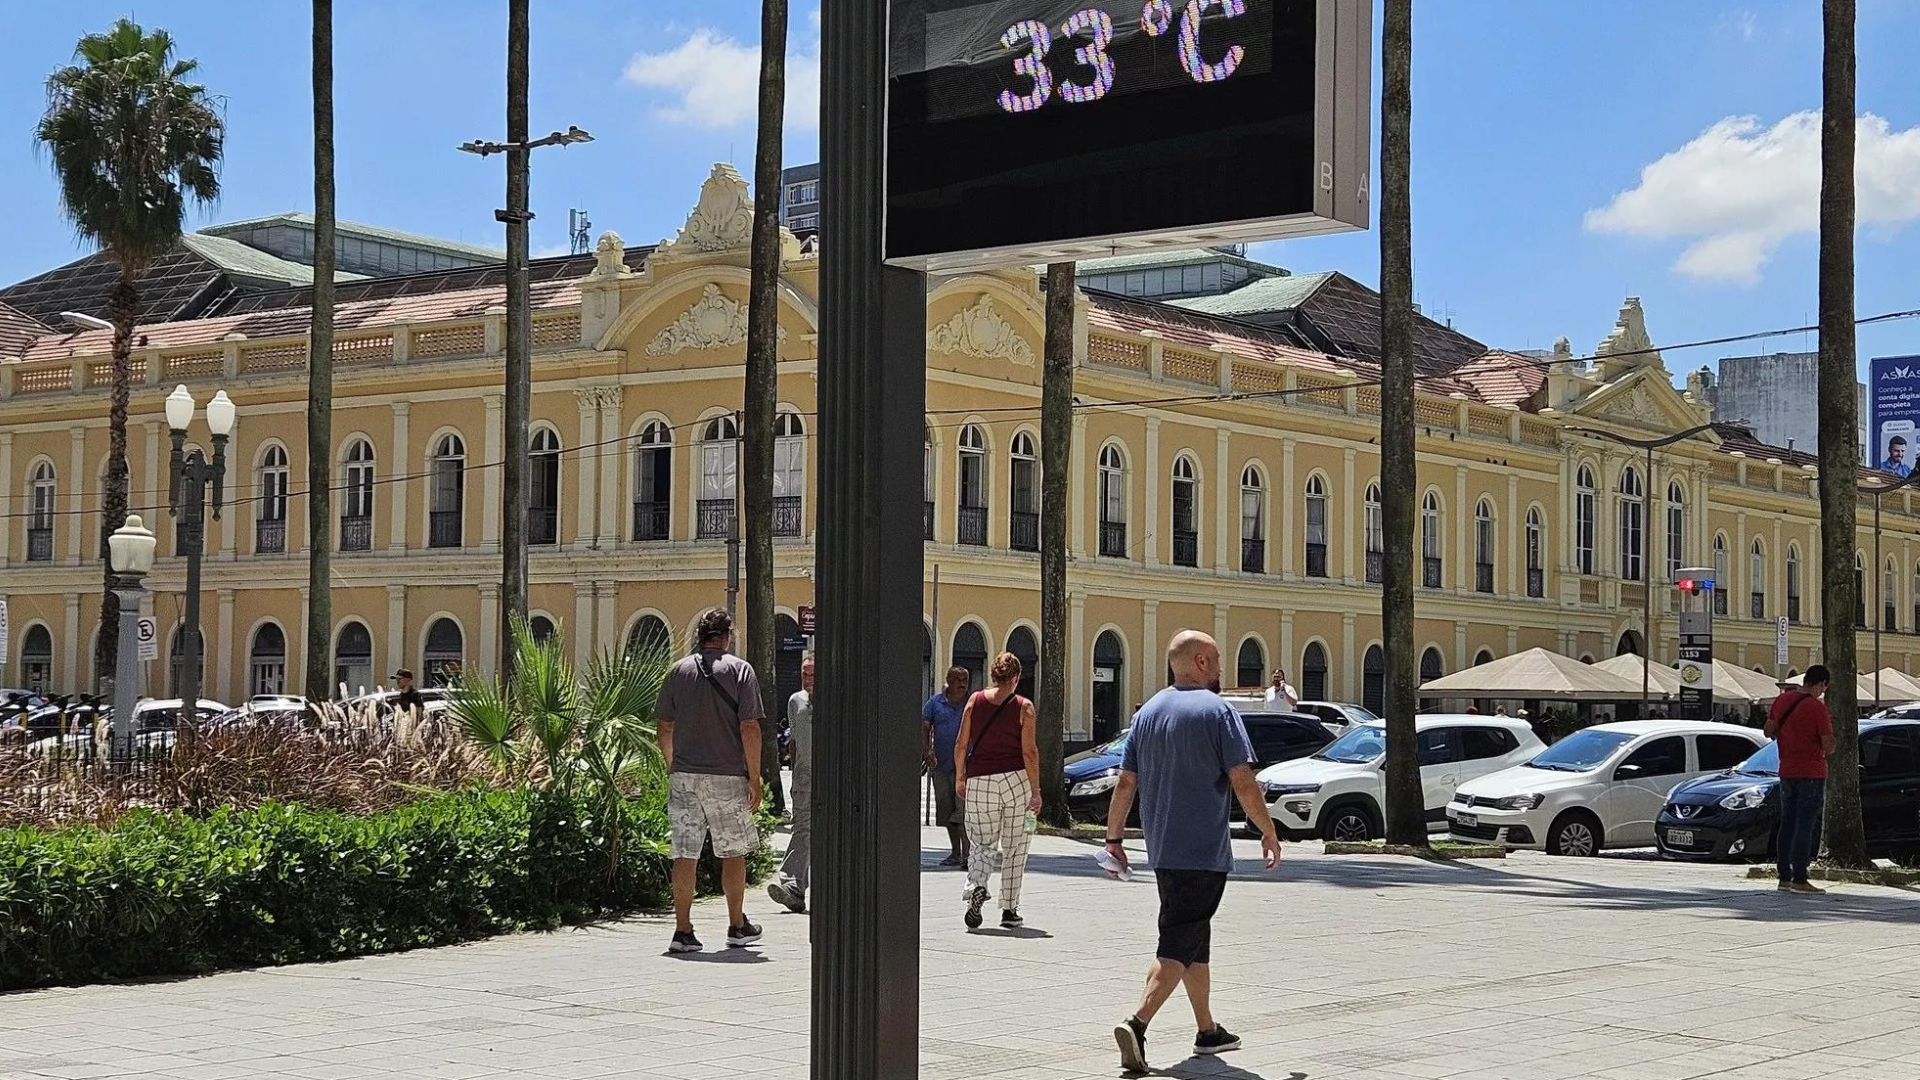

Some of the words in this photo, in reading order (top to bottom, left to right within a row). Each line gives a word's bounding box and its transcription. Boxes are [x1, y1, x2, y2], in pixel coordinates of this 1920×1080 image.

[998, 8, 1116, 113] 33
[1321, 161, 1333, 190] B
[1357, 172, 1369, 201] A
[1878, 401, 1911, 409] completa
